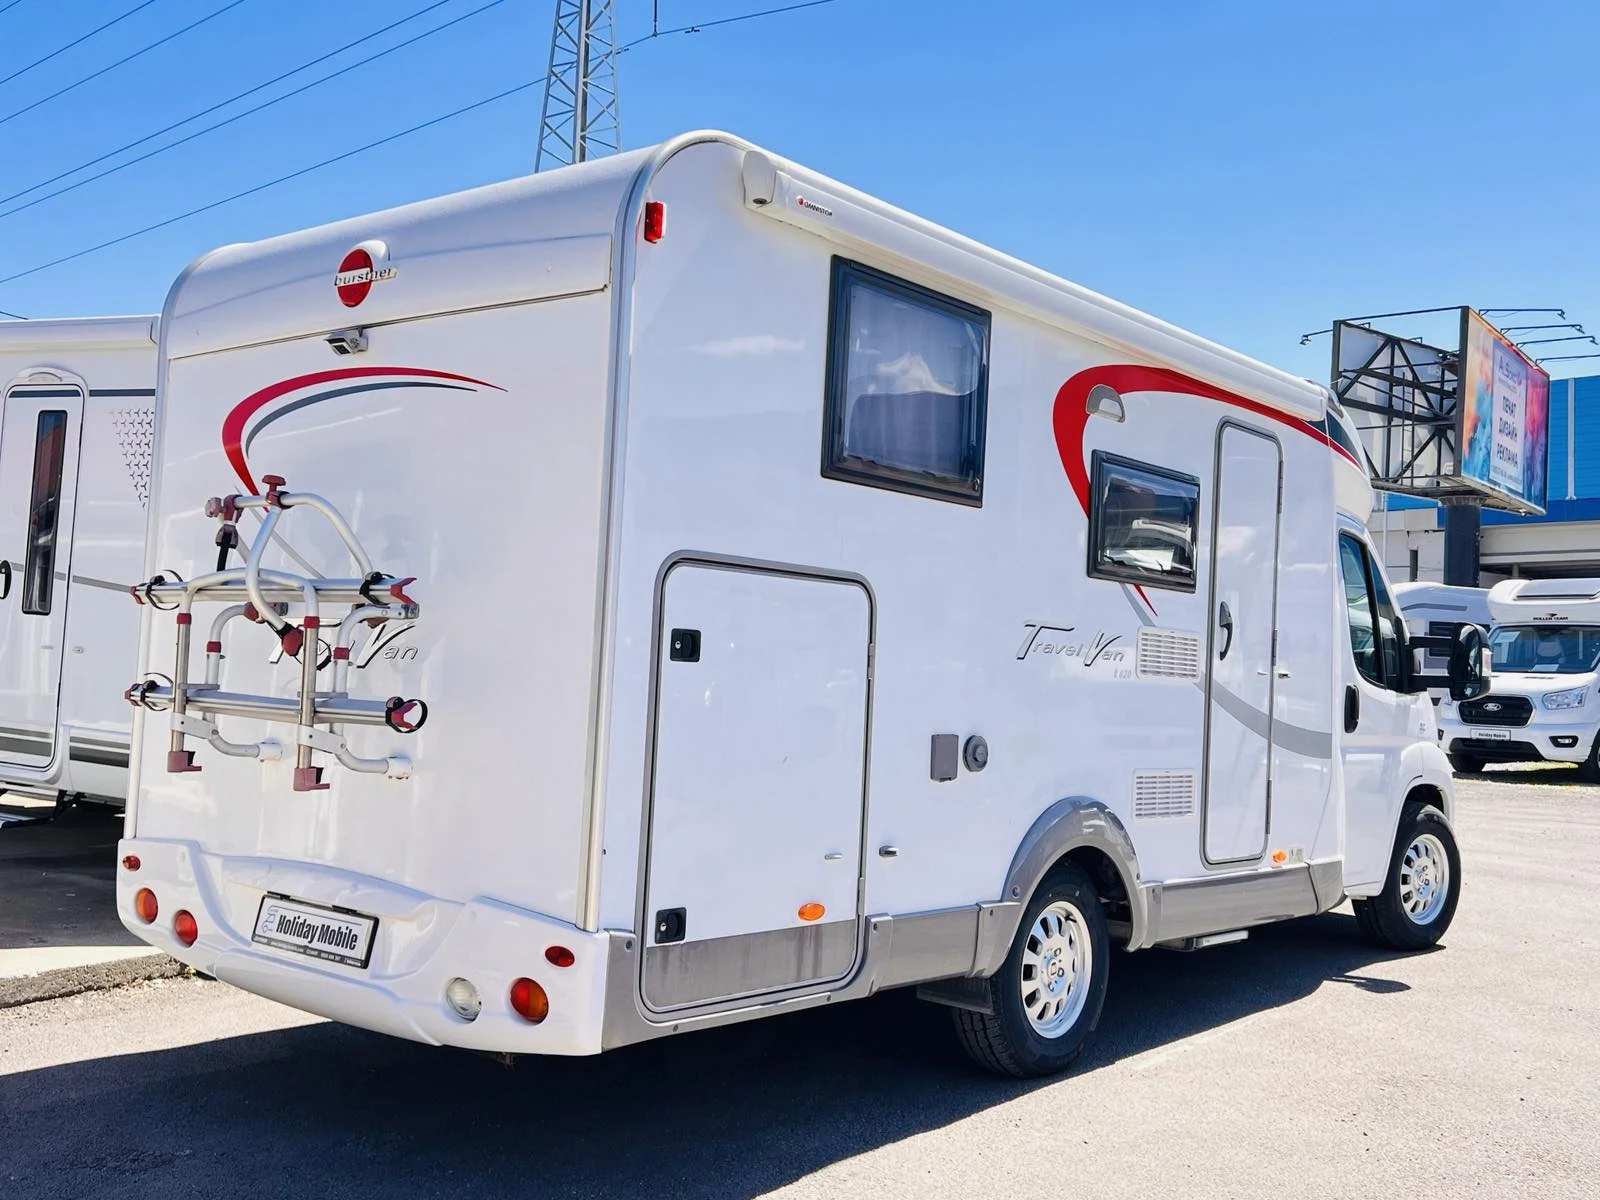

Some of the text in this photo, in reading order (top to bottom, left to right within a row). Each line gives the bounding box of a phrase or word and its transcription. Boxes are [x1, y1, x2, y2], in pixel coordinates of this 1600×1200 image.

[803, 201, 833, 216] OMNISTOR
[276, 914, 319, 944] Holiday
[317, 923, 358, 951] Mobile
